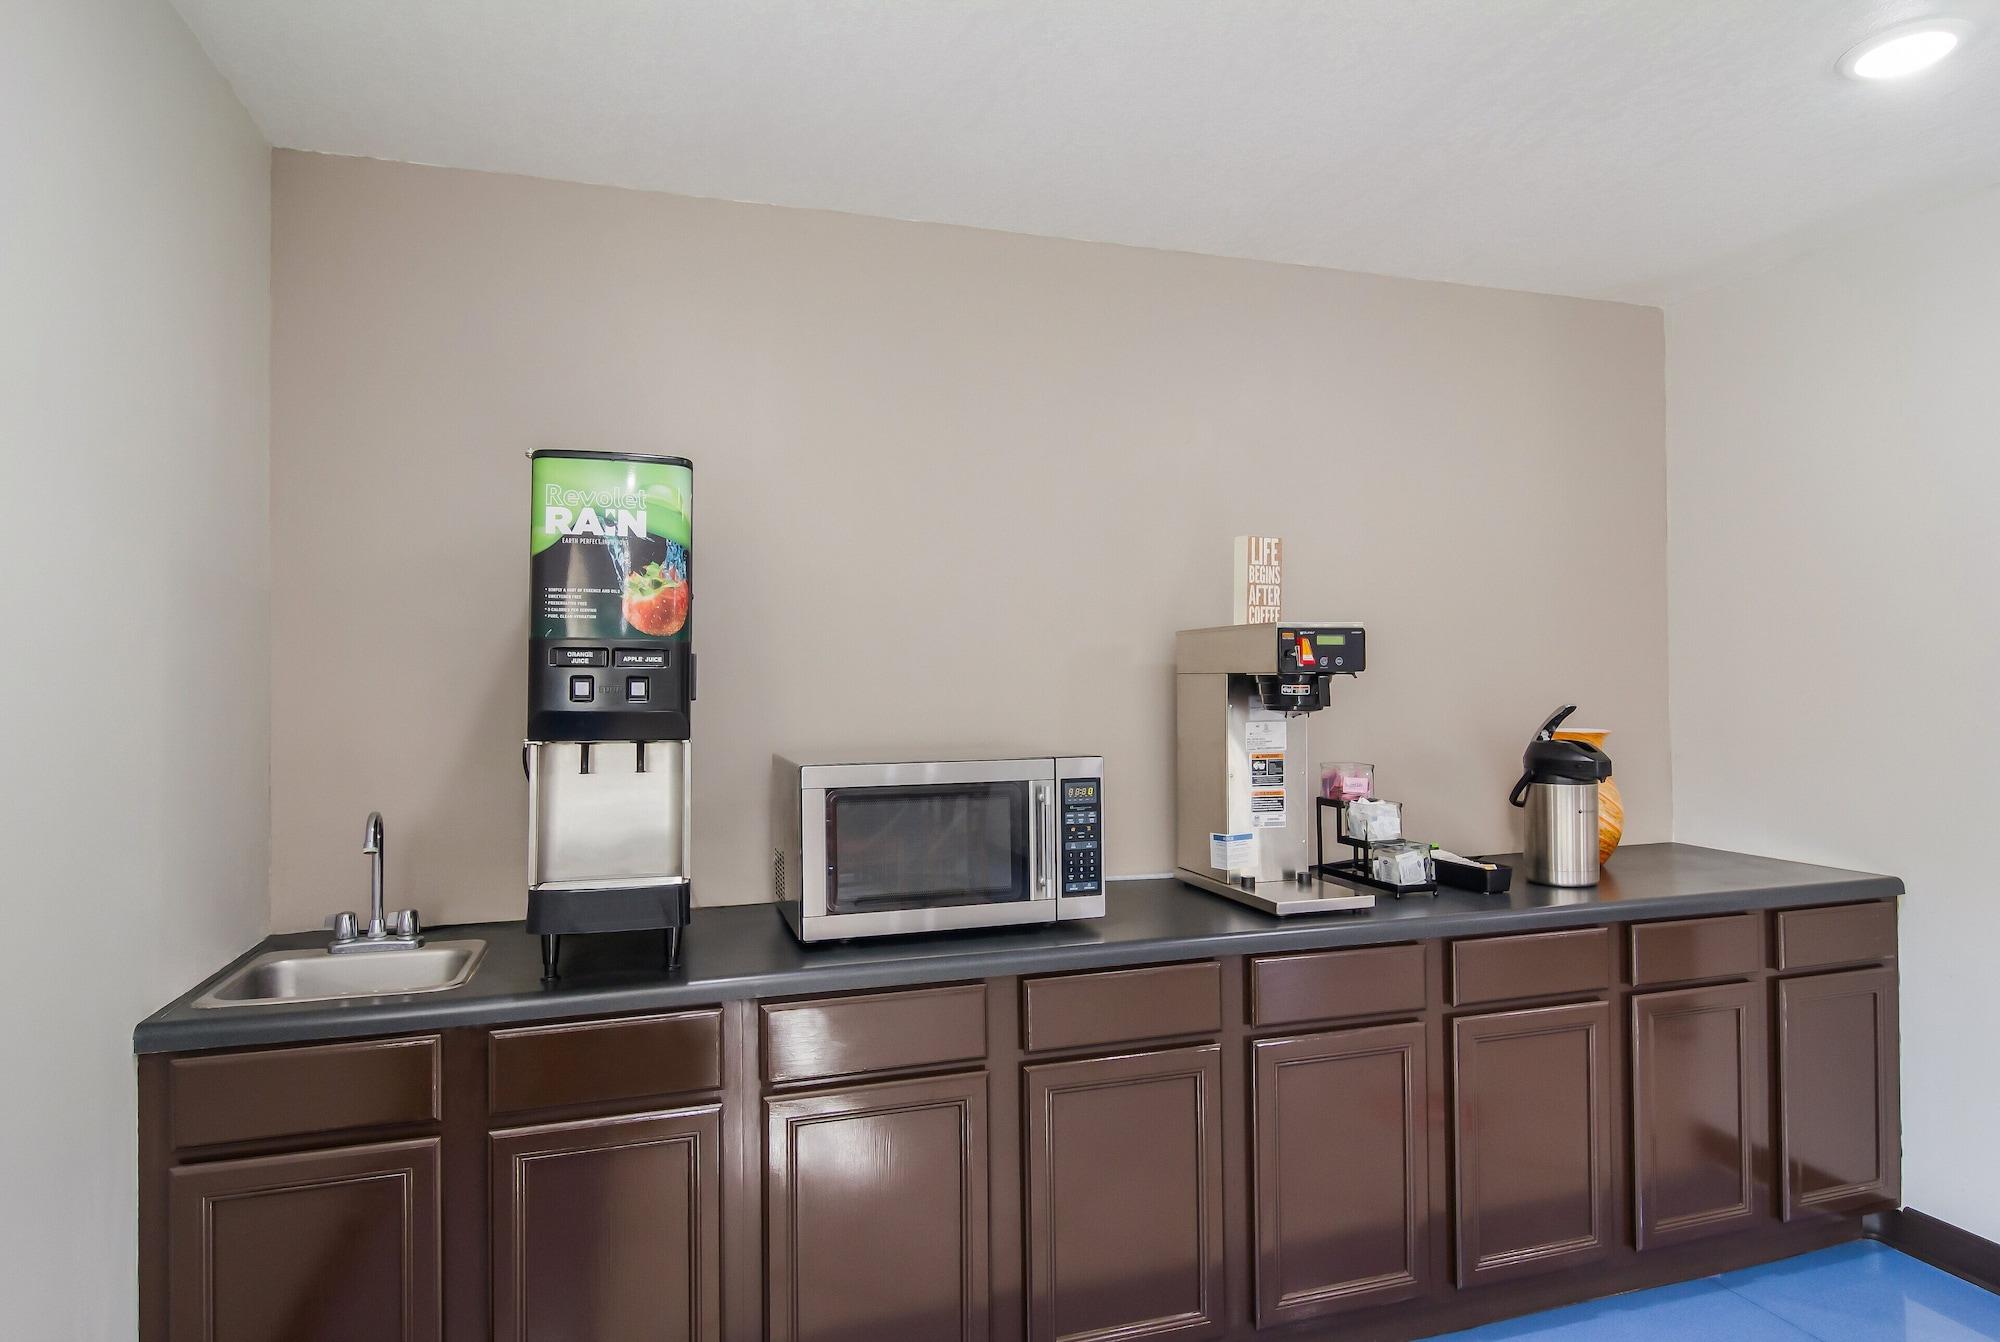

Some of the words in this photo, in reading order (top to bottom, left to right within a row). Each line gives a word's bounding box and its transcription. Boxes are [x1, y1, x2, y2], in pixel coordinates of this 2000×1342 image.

[545, 483, 648, 510] Revolet
[1251, 536, 1280, 566] LIFE
[1248, 565, 1281, 585] BEGINS
[1248, 584, 1281, 606] AFTER
[1248, 605, 1281, 625] COFFEE
